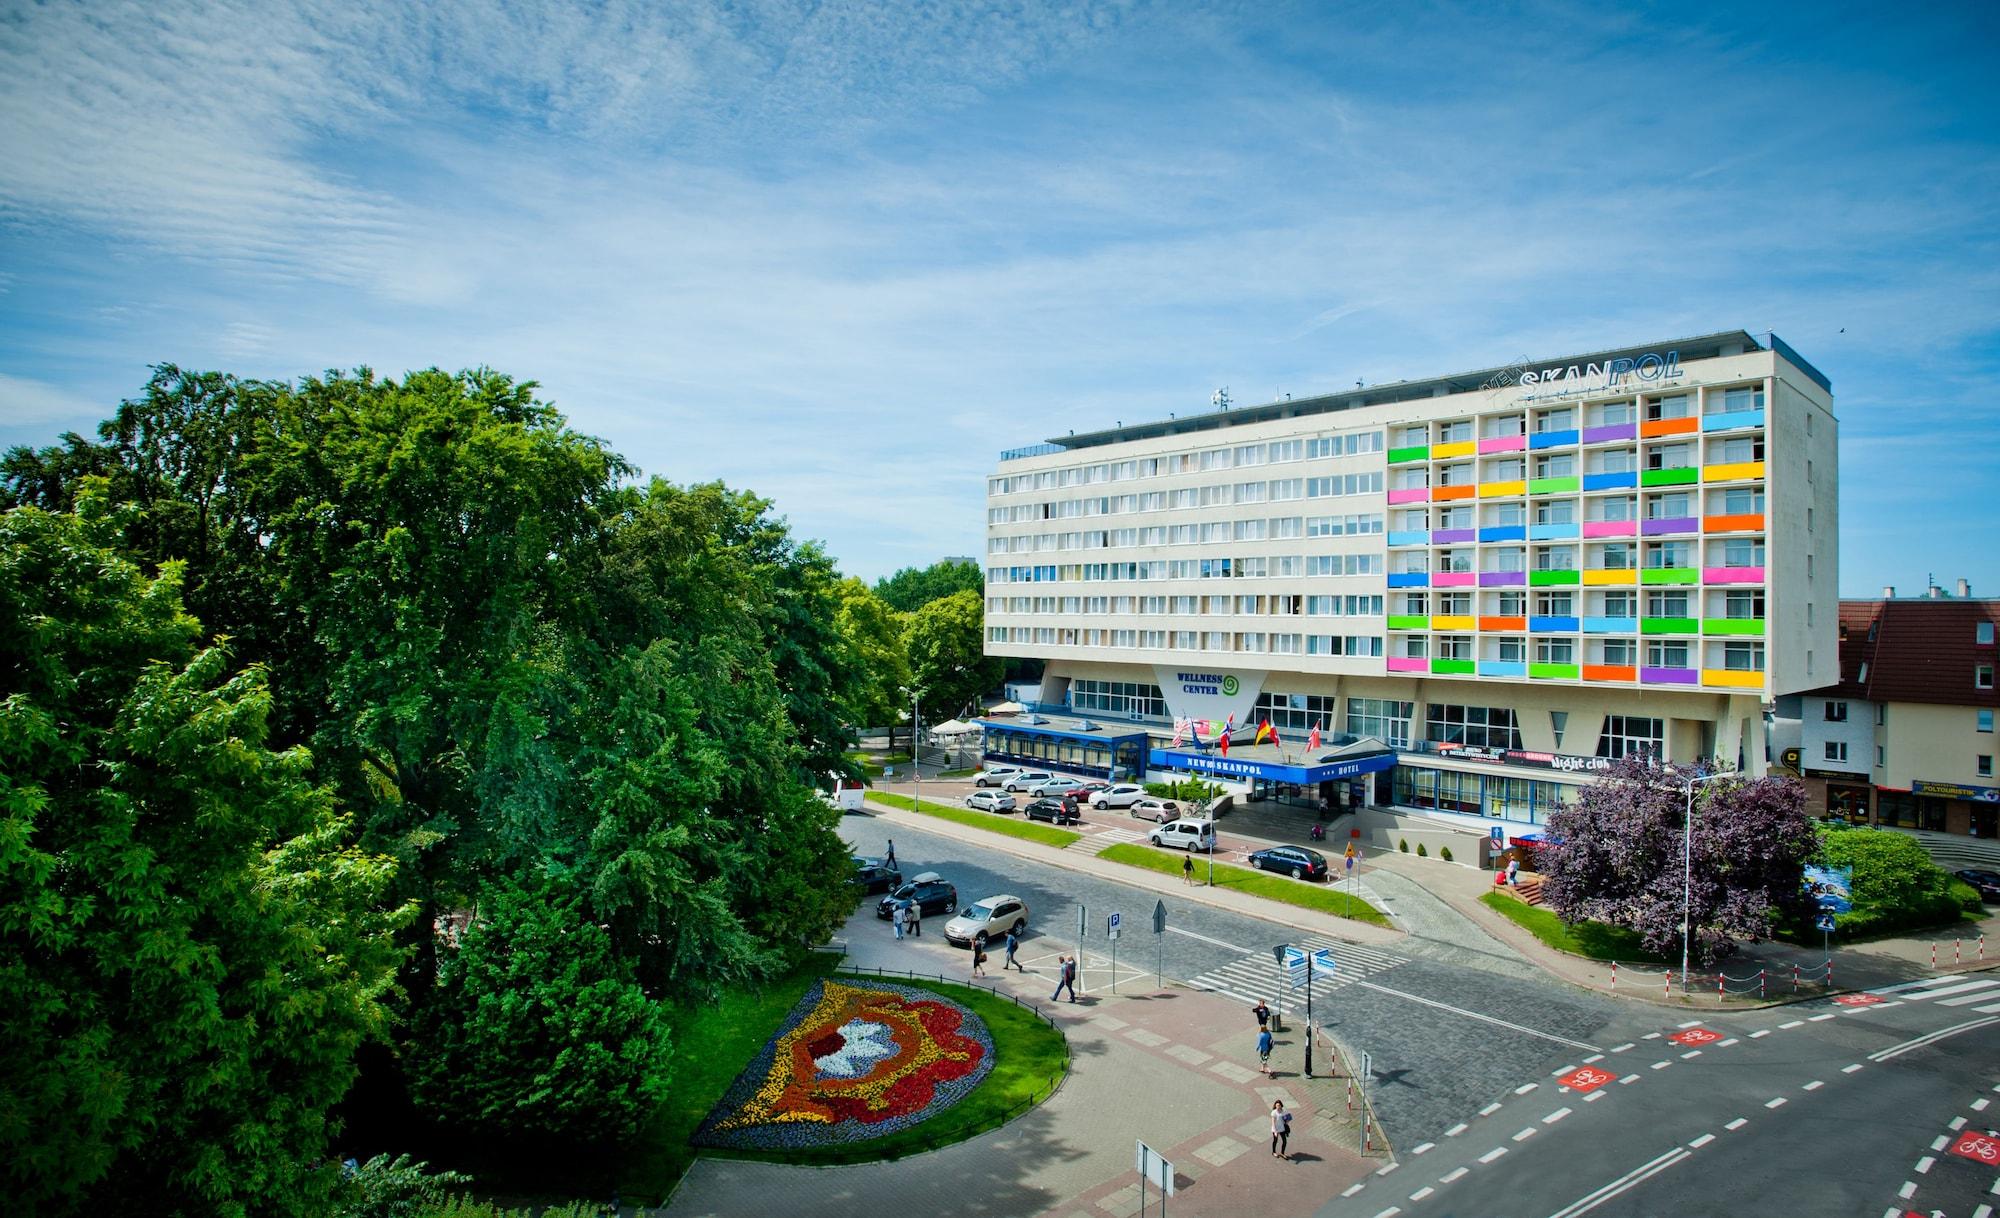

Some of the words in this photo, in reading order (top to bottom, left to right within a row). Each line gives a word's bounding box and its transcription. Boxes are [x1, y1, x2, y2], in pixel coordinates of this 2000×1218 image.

[1519, 350, 1684, 399] SKANPOL
[1177, 672, 1223, 684] WELLNESS
[1183, 684, 1218, 695] CENTER
[1187, 757, 1208, 768] NEW
[1216, 761, 1262, 775] SKANPOL
[1338, 764, 1360, 776] HOTEL
[1551, 757, 1585, 772] Night
[1586, 758, 1610, 770] club
